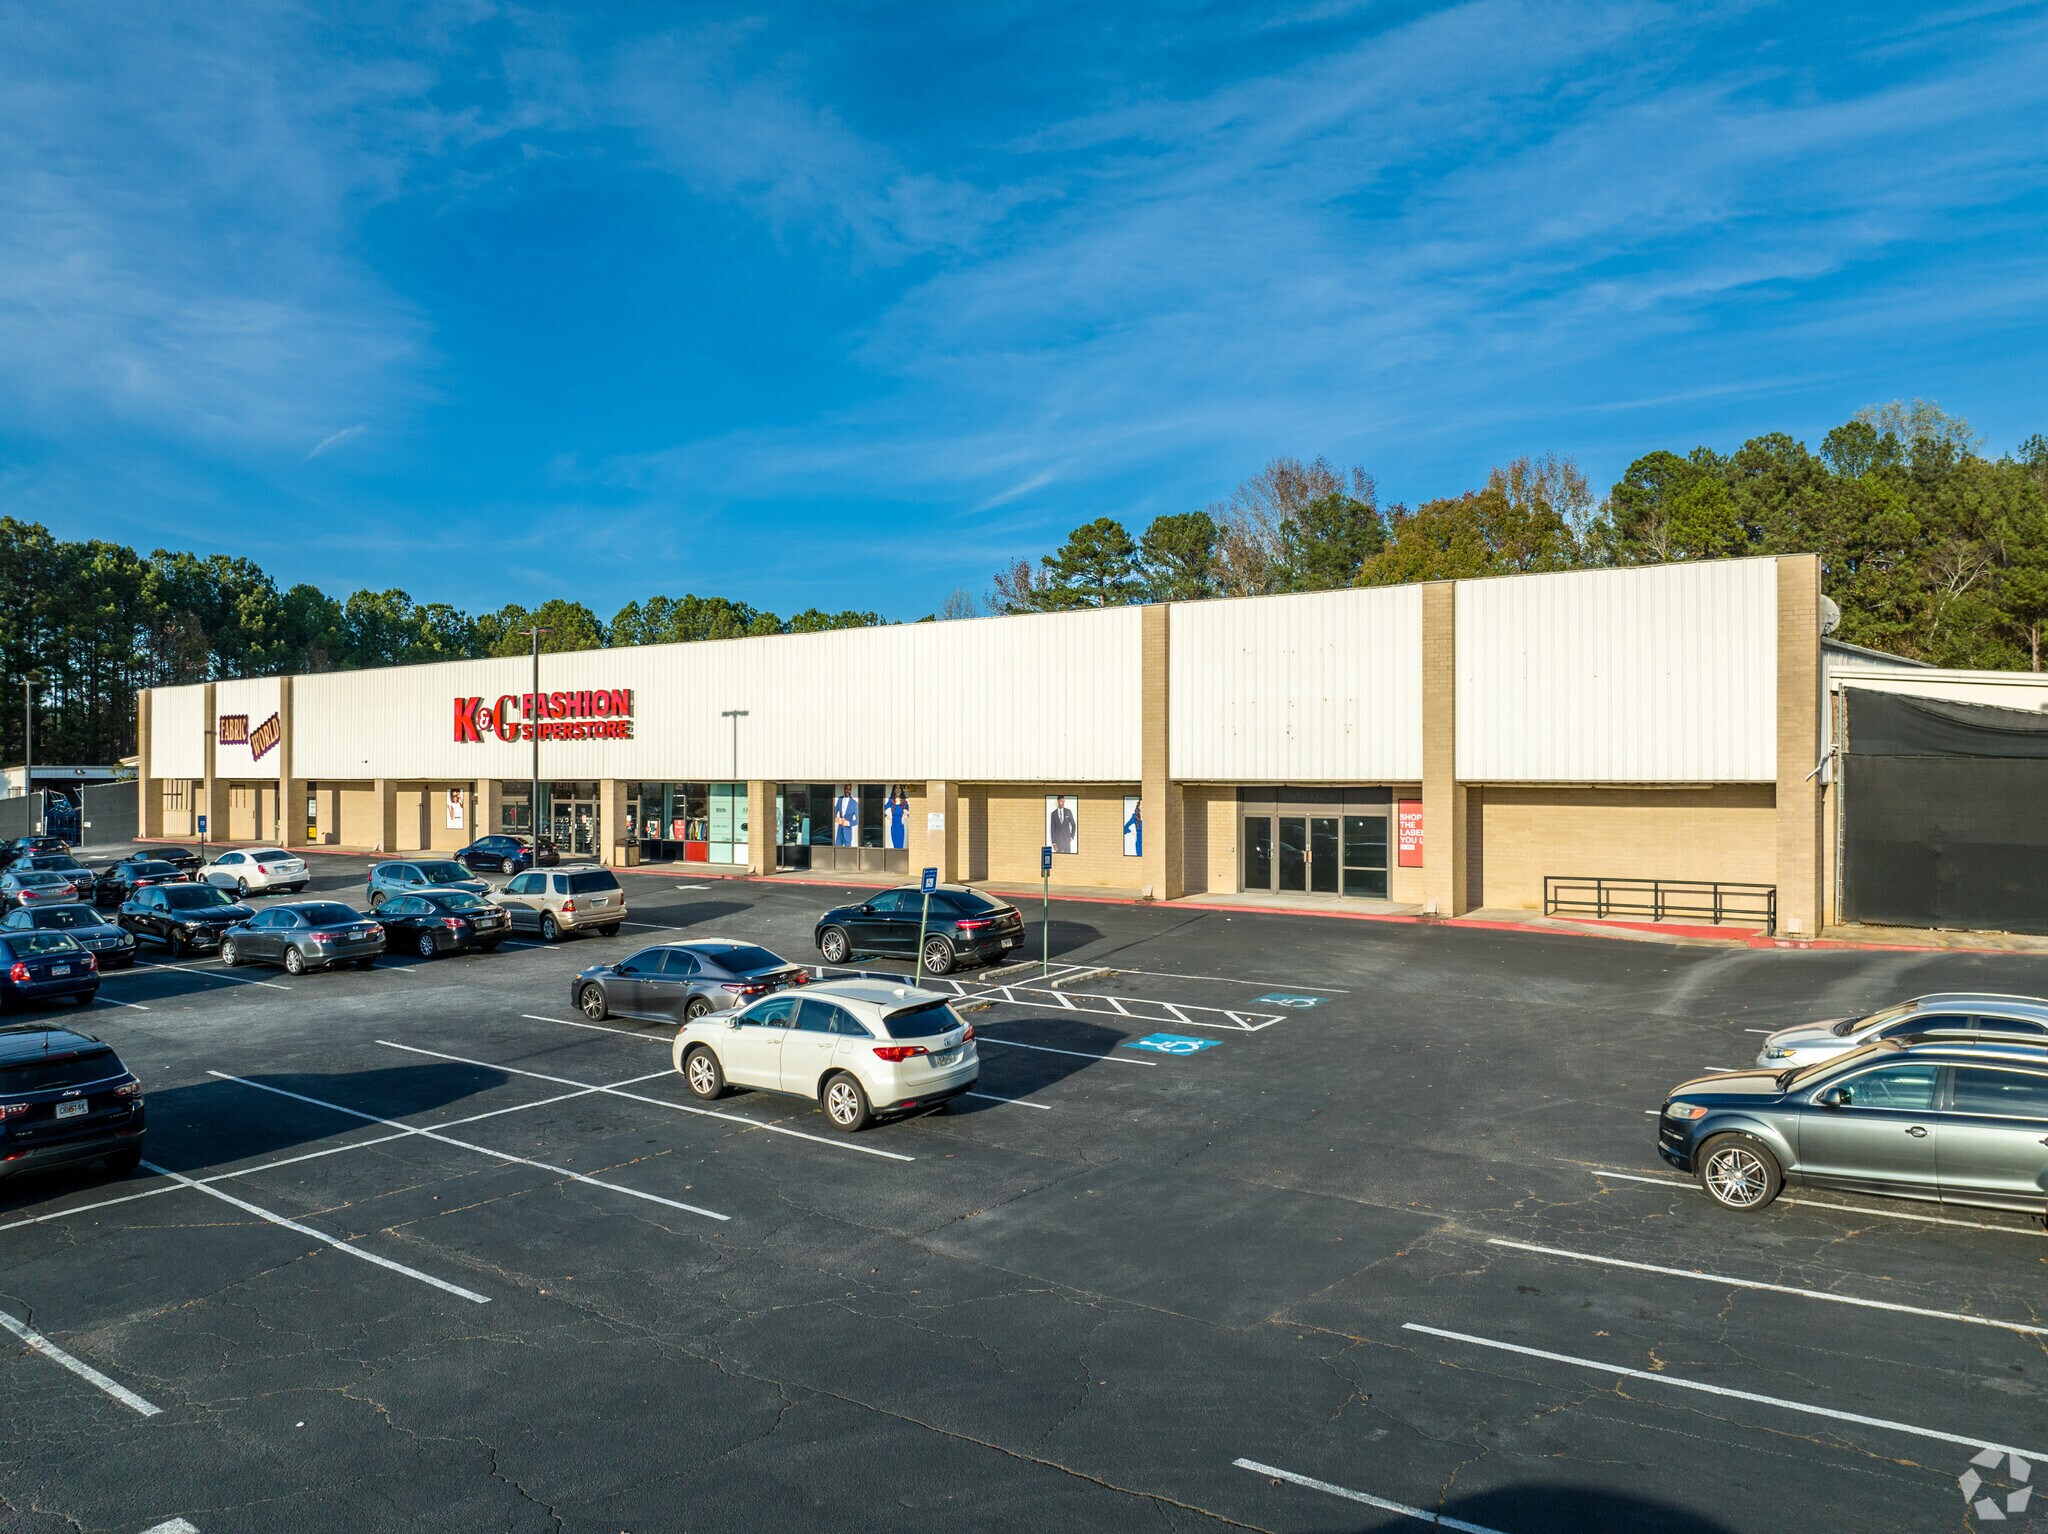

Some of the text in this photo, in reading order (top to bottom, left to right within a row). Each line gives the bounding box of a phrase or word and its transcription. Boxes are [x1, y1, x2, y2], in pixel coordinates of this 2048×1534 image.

[522, 689, 630, 719] FASHION
[220, 718, 247, 741] FABRIC
[454, 695, 522, 742] K&G
[251, 718, 280, 756] WORLD
[1400, 813, 1423, 821] SHOP
[1400, 821, 1416, 829] THE
[1400, 829, 1424, 837] LABE
